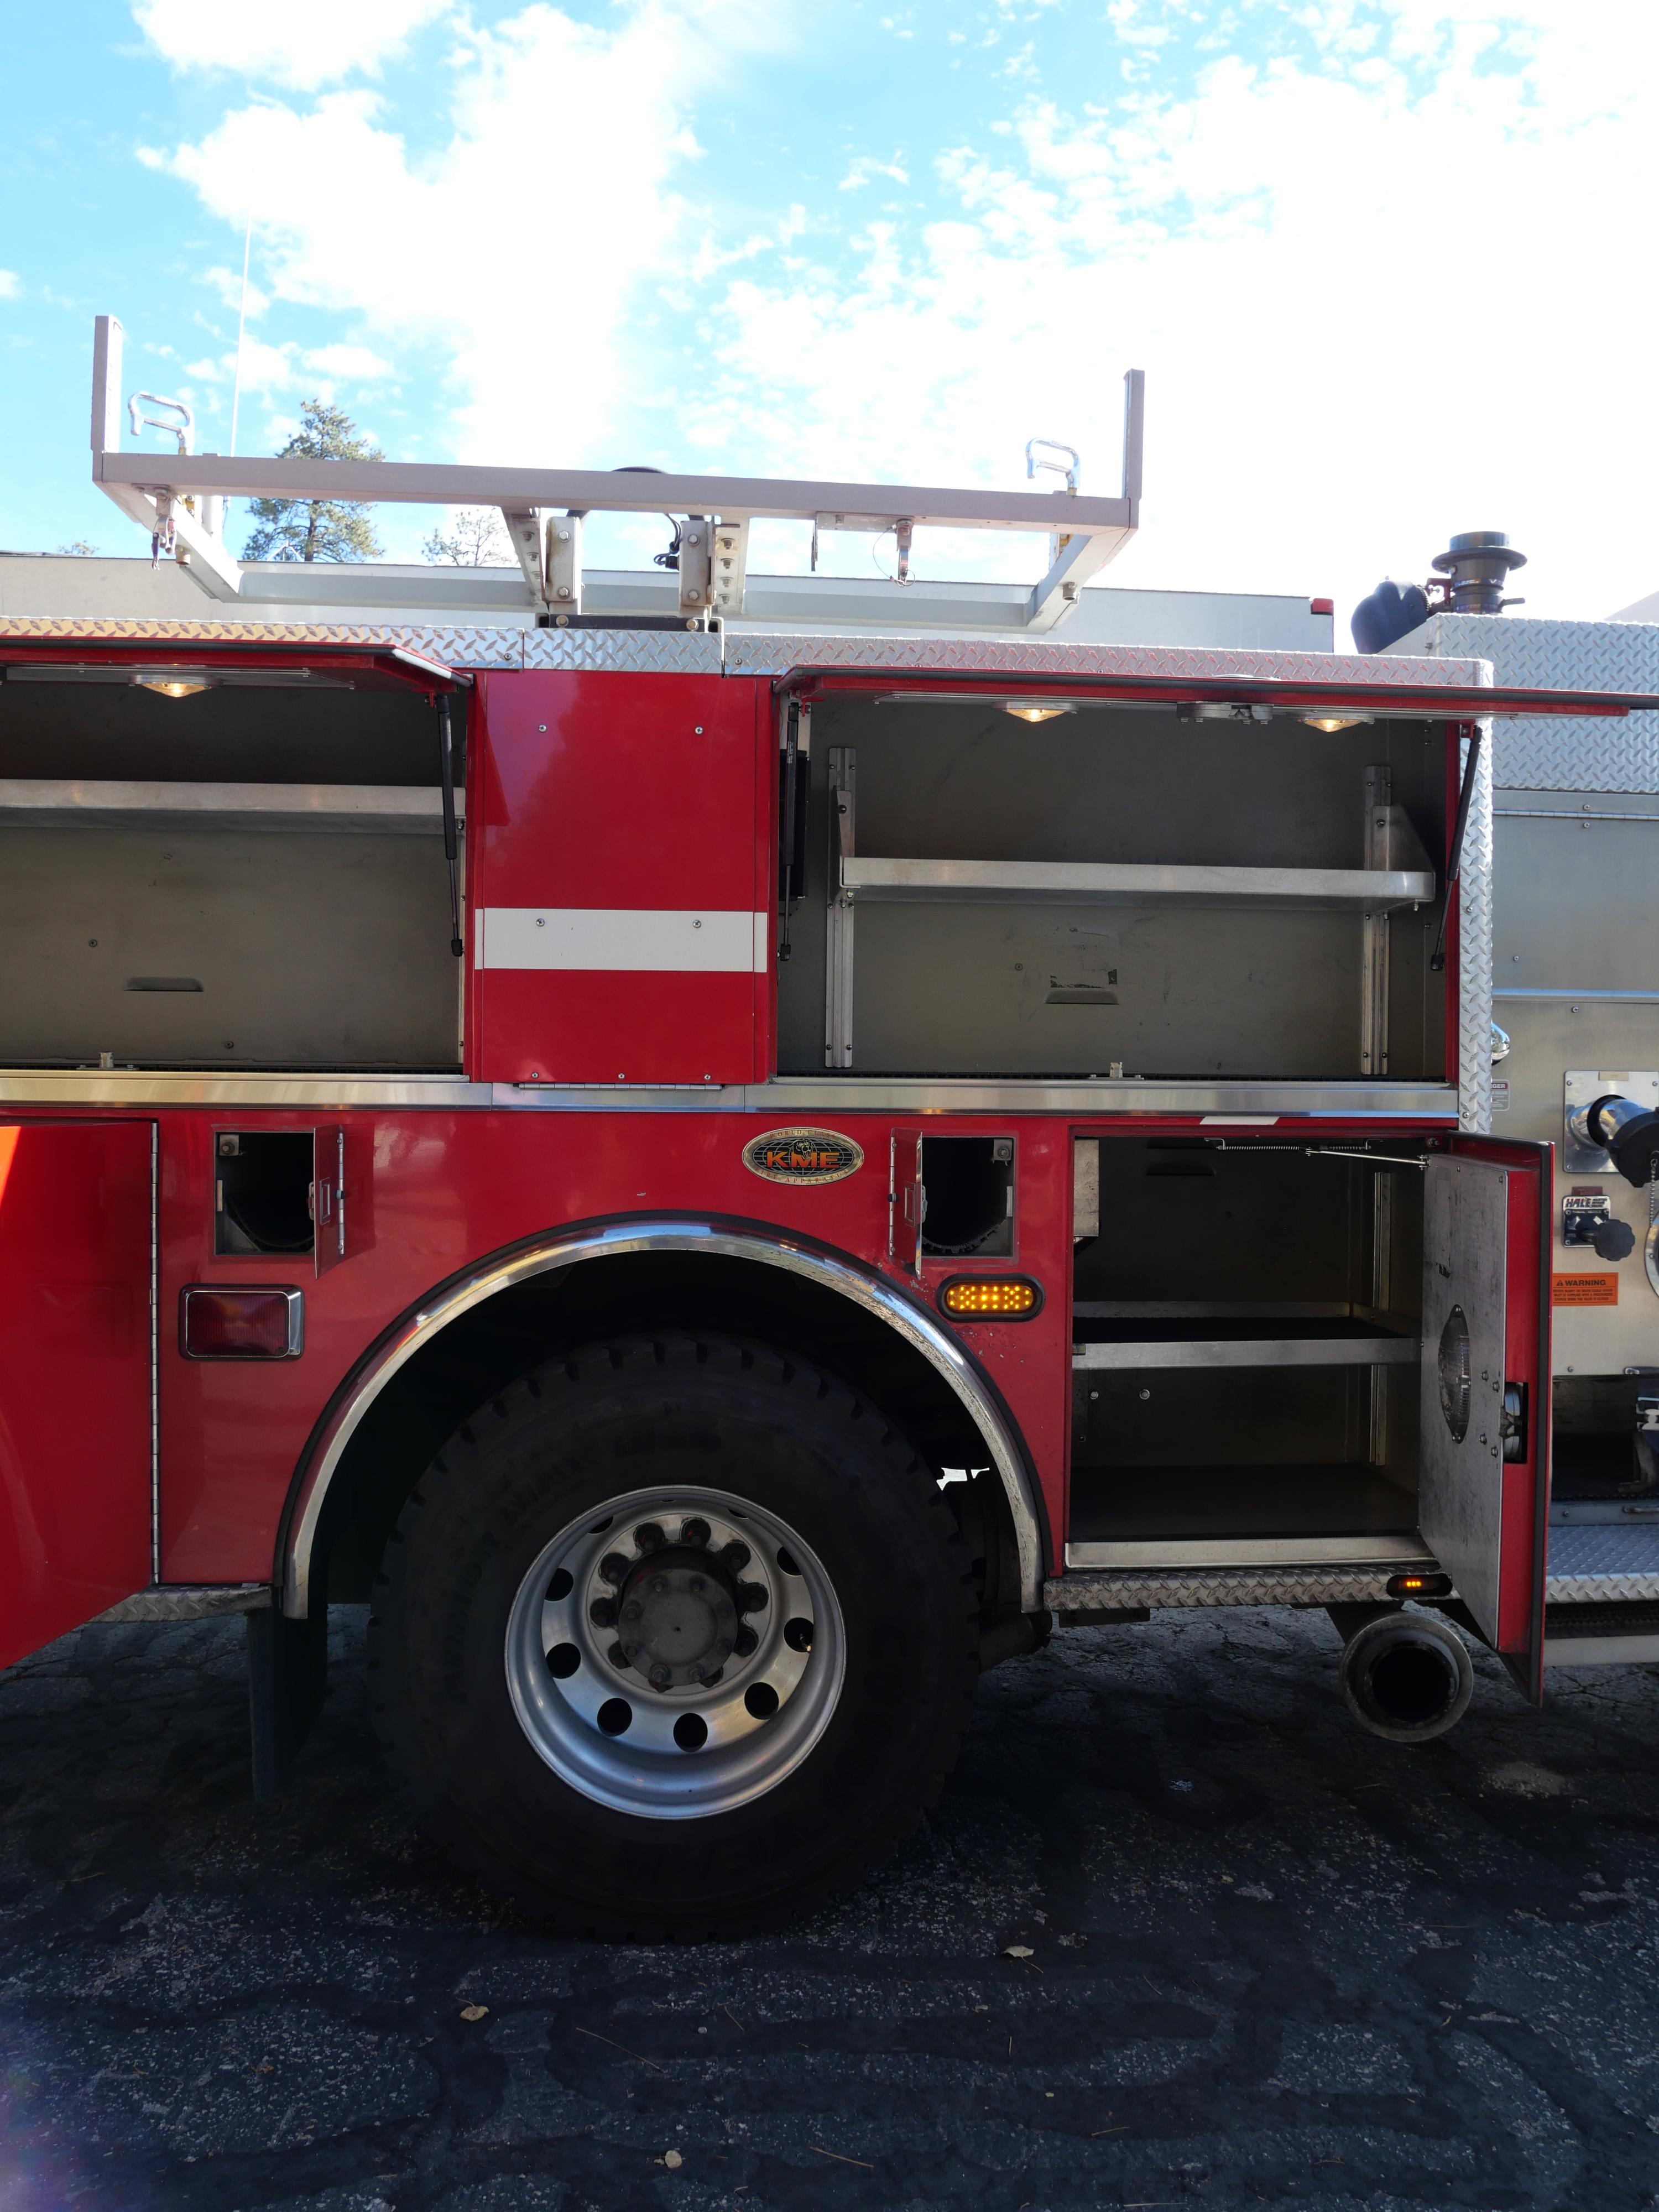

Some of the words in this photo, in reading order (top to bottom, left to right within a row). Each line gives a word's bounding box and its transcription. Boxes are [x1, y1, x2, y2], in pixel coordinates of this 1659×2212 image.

[769, 1129, 802, 1139] WORLD
[807, 1130, 836, 1139] CLASS
[766, 1151, 839, 1168] KME
[755, 1167, 778, 1180] FIRE
[785, 1169, 848, 1183] APPARATUS
[1566, 1198, 1592, 1208] HALE
